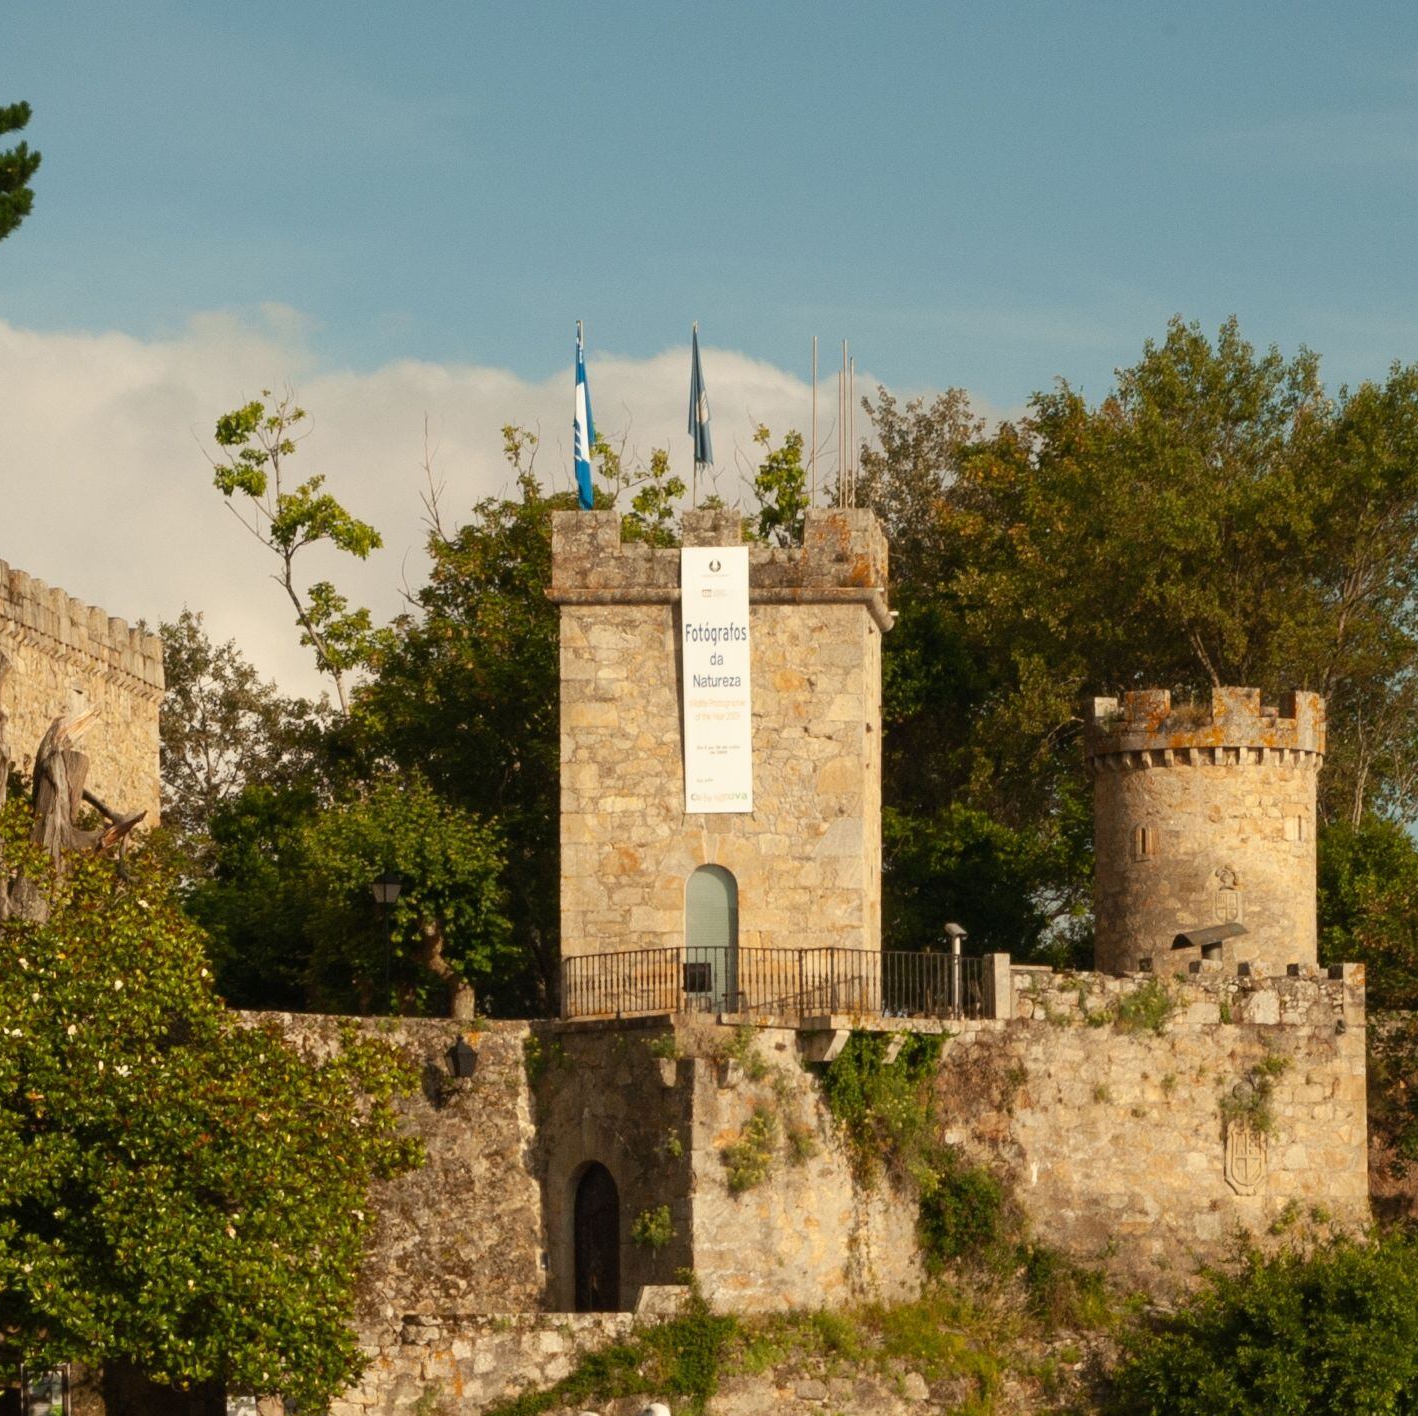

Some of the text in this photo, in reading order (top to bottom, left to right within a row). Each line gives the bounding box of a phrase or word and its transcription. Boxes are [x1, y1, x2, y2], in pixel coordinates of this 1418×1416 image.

[686, 621, 747, 646] Fotógrafos
[710, 651, 724, 666] da
[693, 674, 741, 688] Natureza
